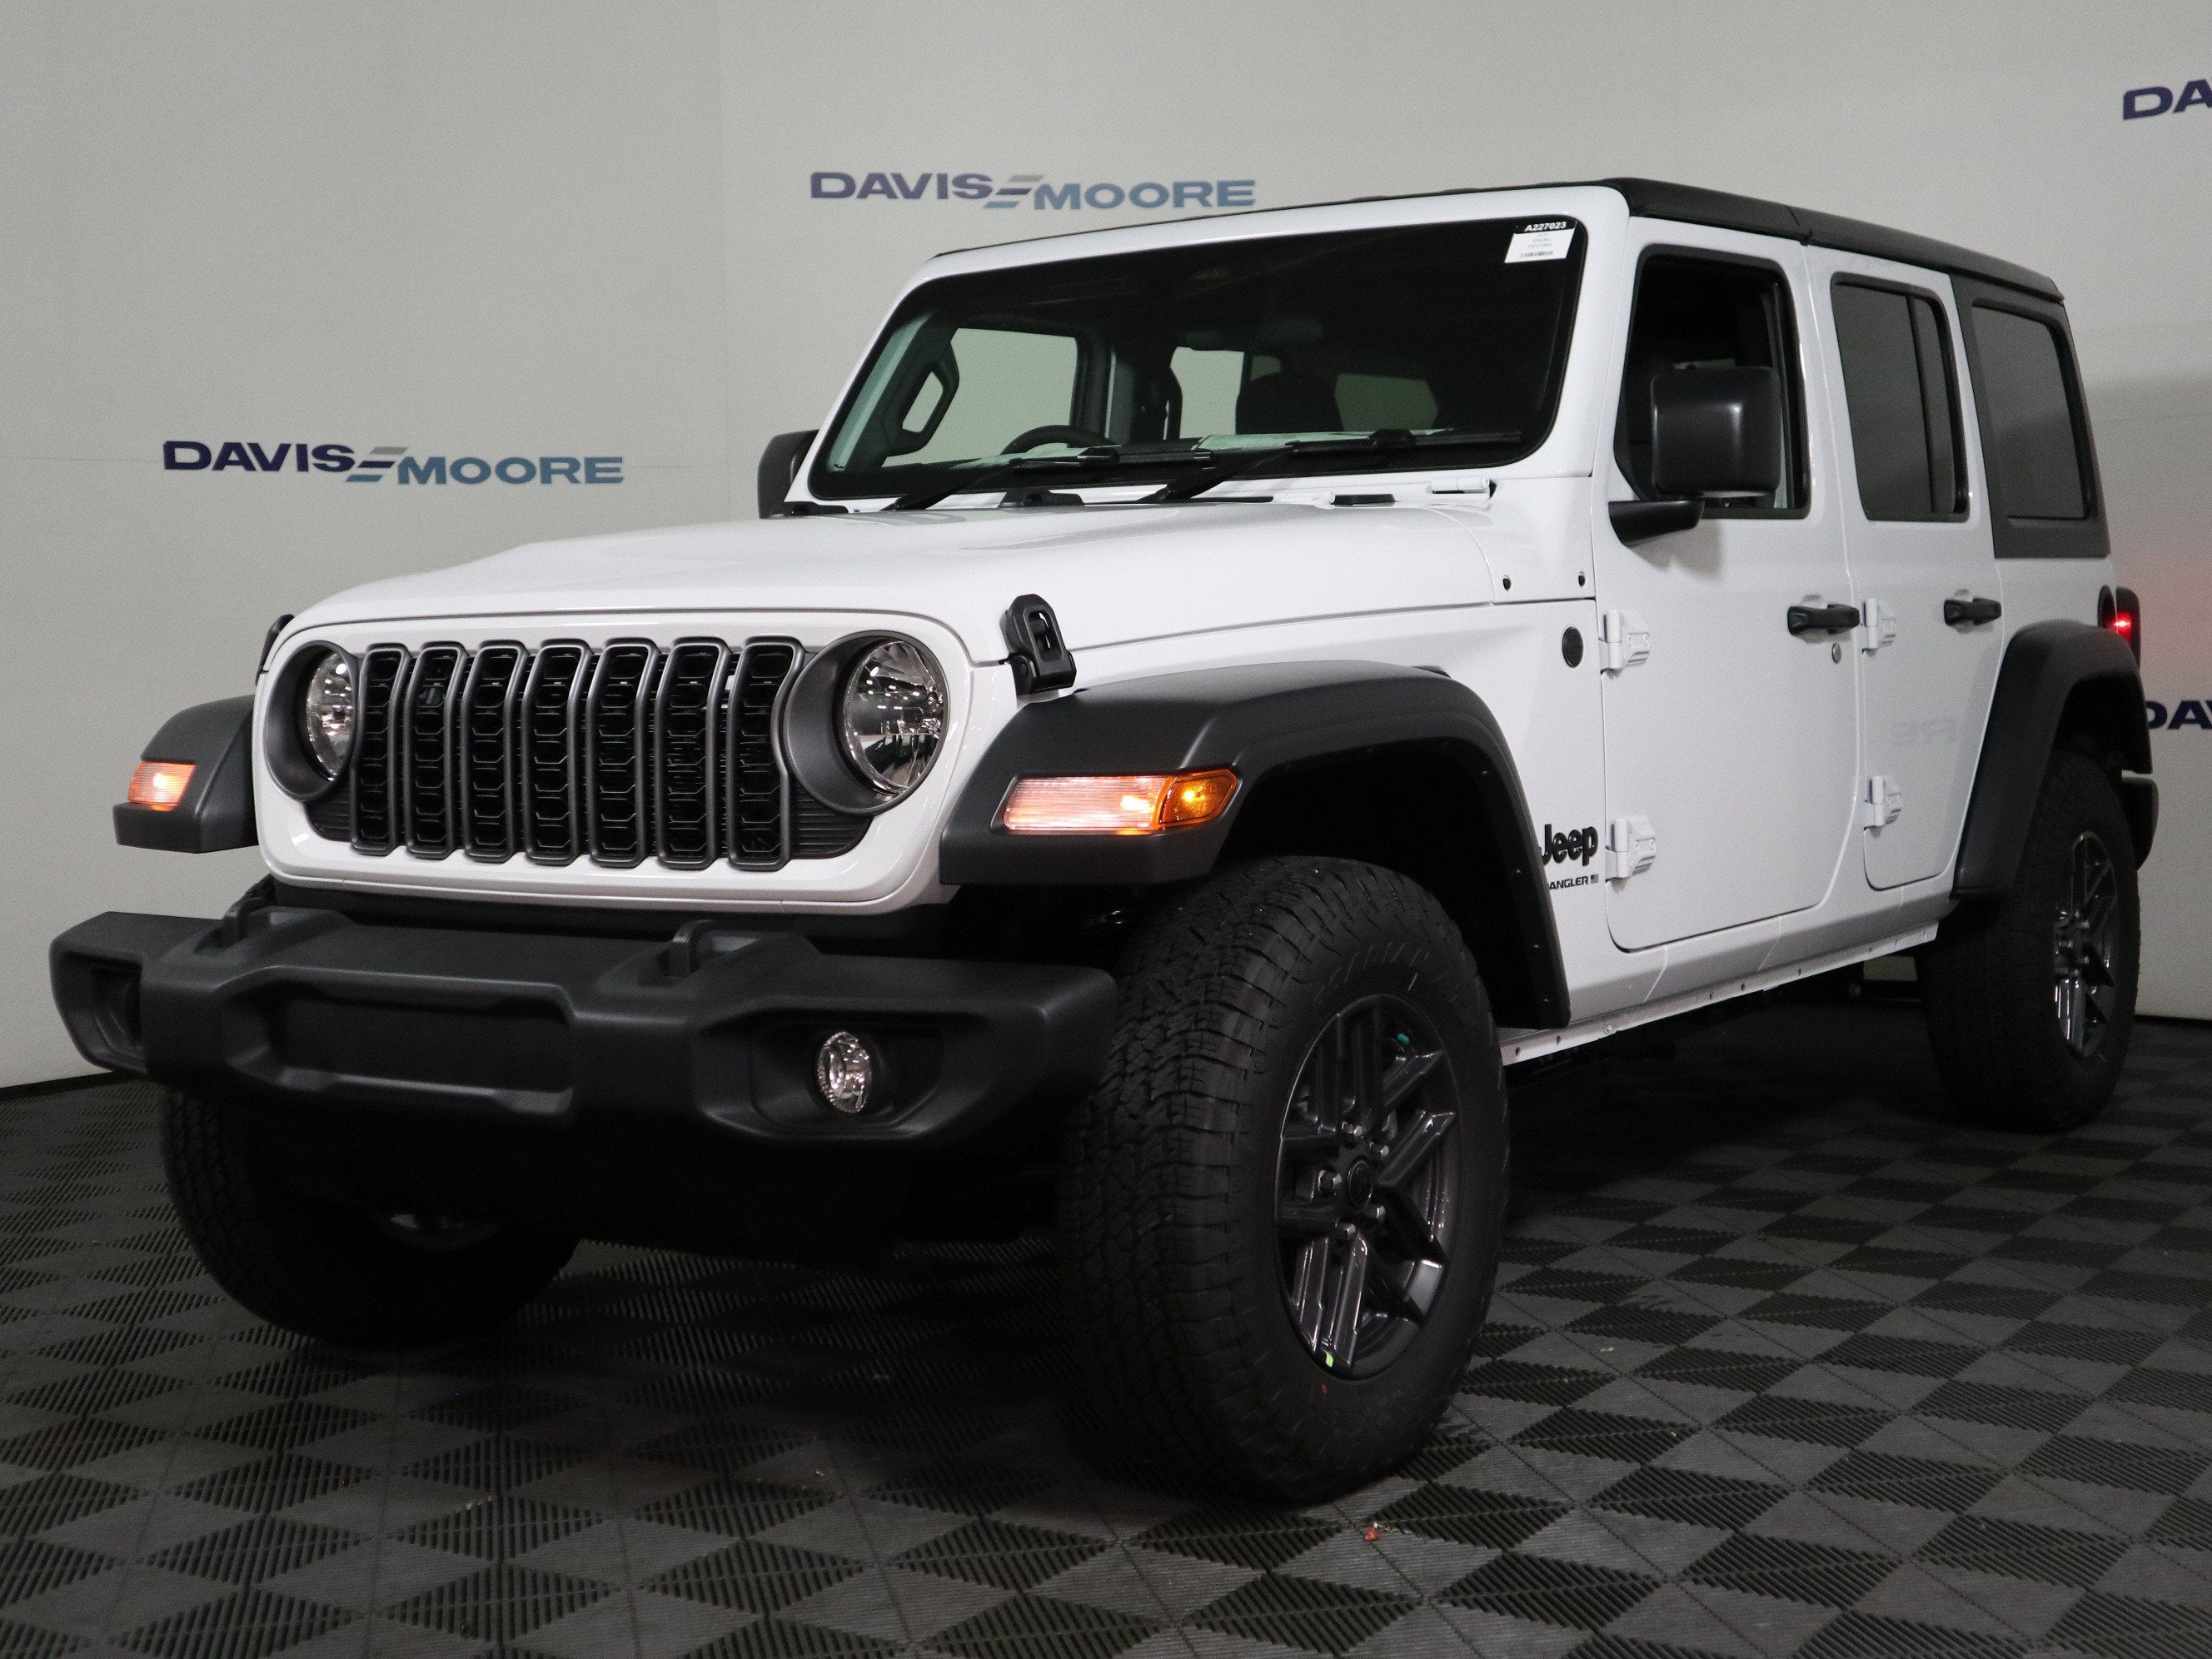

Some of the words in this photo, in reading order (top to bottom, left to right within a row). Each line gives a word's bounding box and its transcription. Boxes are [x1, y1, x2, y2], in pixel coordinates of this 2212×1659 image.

[810, 172, 993, 200] DAVIS
[1034, 180, 1255, 210] MOORE
[1524, 221, 1567, 232] A227023
[162, 440, 356, 473] DAVIS
[397, 456, 624, 485] MOORE
[1542, 823, 1599, 867] Jeep
